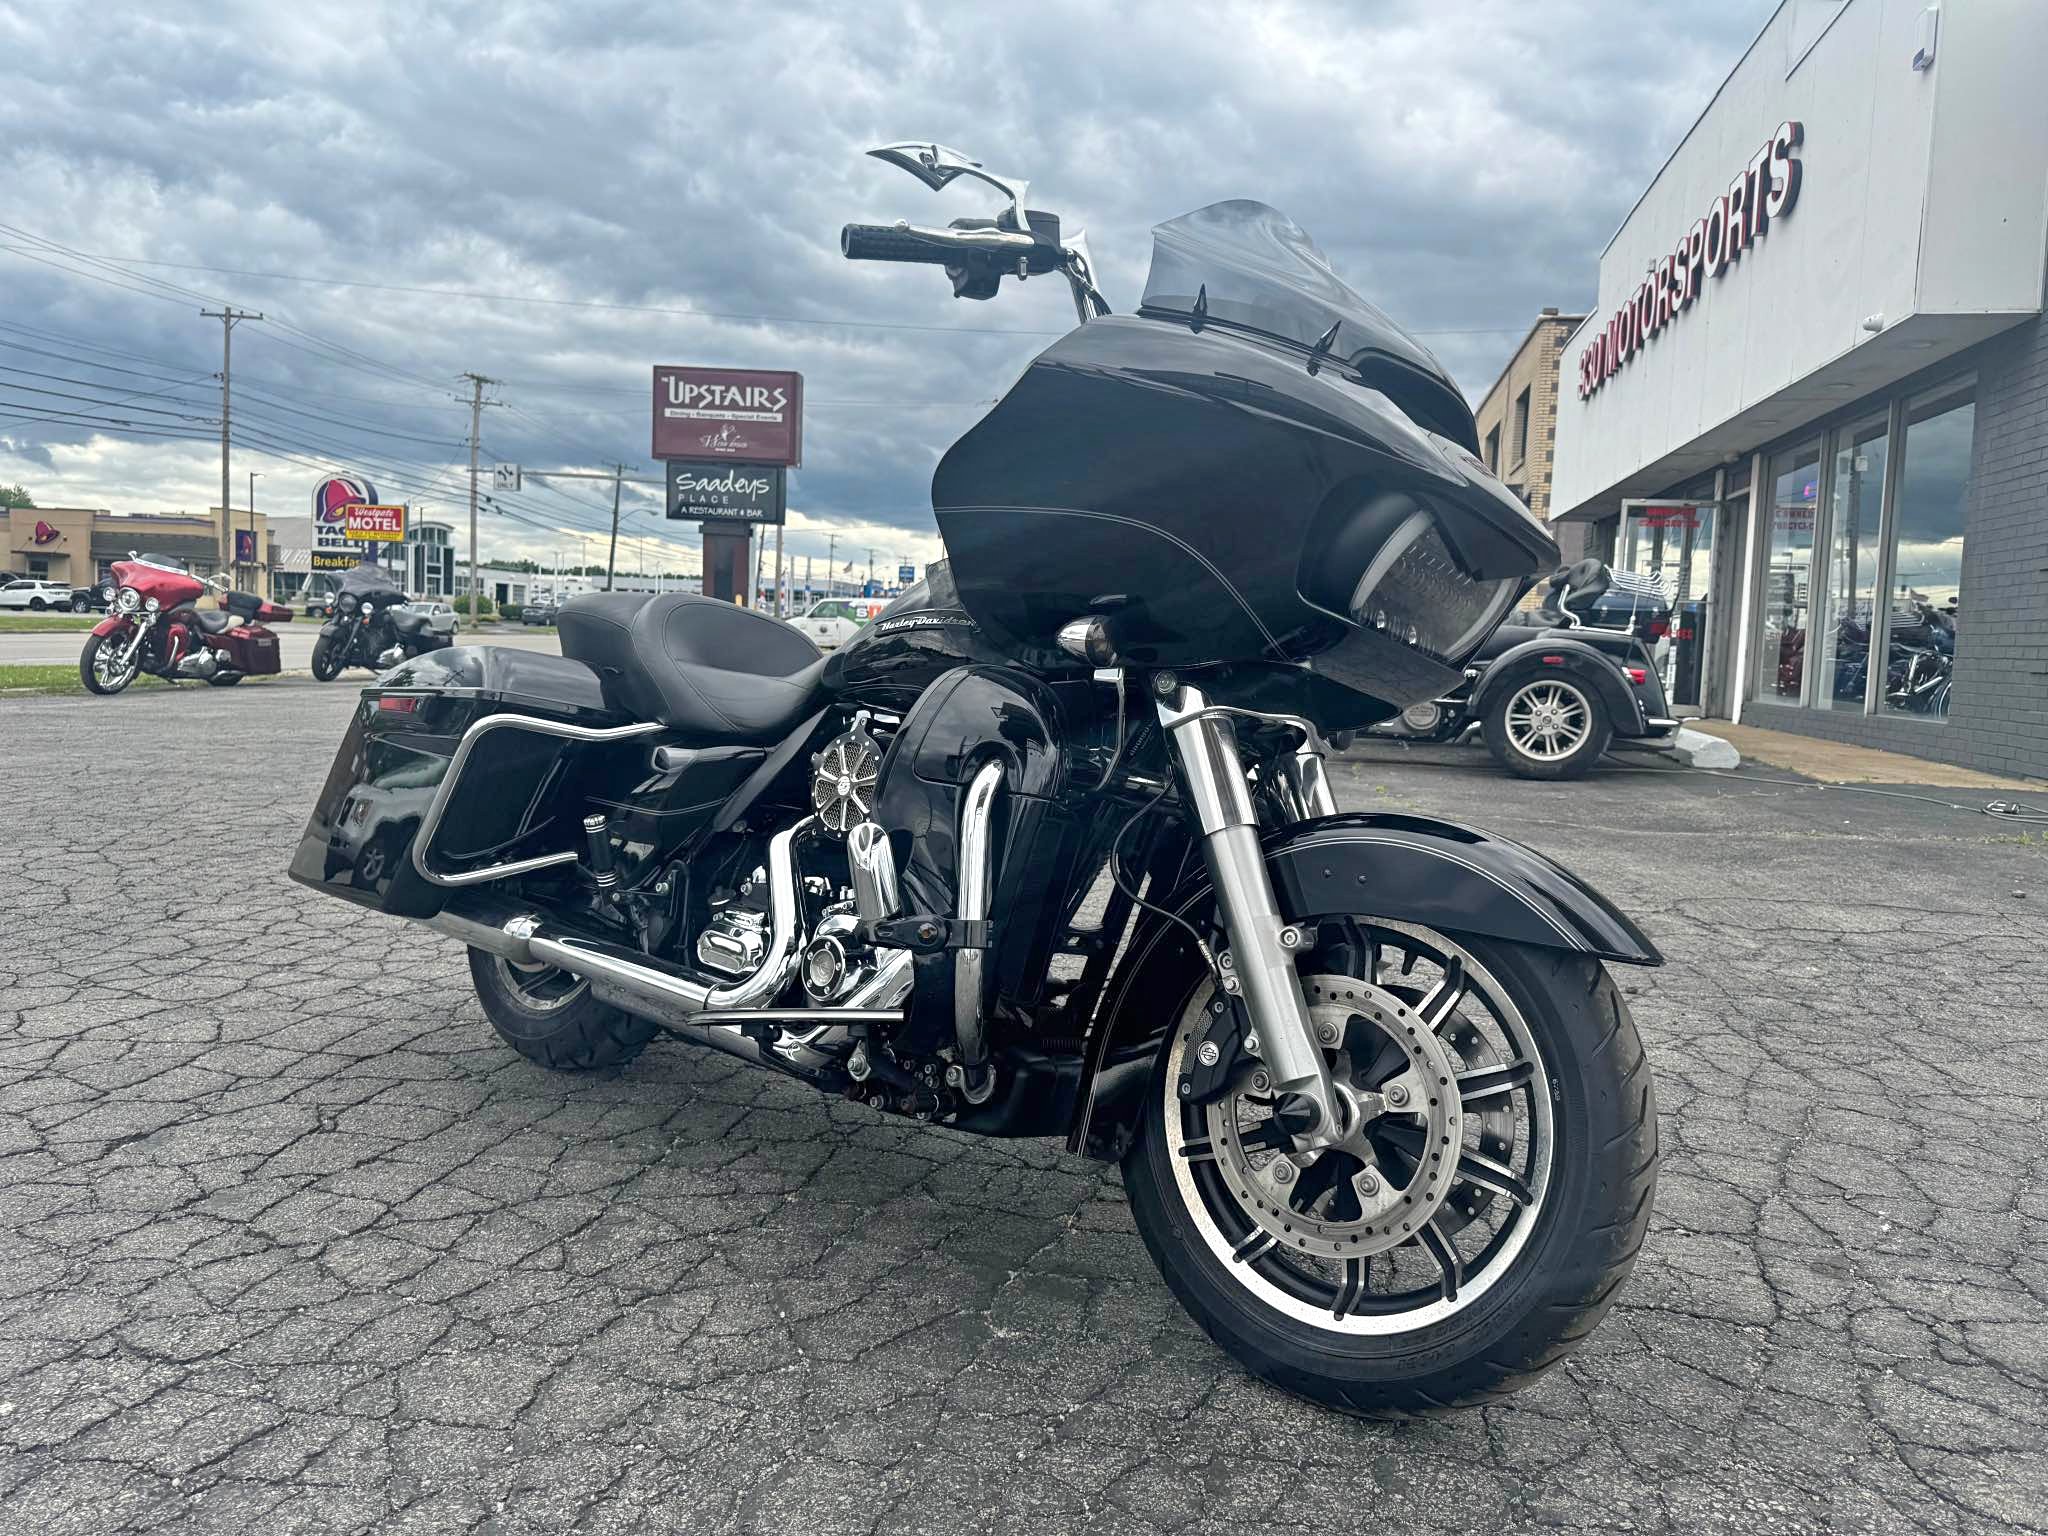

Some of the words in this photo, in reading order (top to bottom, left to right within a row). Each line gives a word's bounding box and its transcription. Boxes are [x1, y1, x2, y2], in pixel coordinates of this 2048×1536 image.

[1604, 121, 1804, 377] MOTORSPORTS
[669, 375, 787, 411] UPSTAIRS
[676, 470, 769, 501] Saadeys
[678, 493, 729, 504] PLACE
[354, 508, 394, 518] Westgate
[689, 507, 737, 517] RESTAURANT
[746, 509, 763, 517] BAR
[349, 517, 400, 530] MOTEL
[315, 526, 345, 536] TAC
